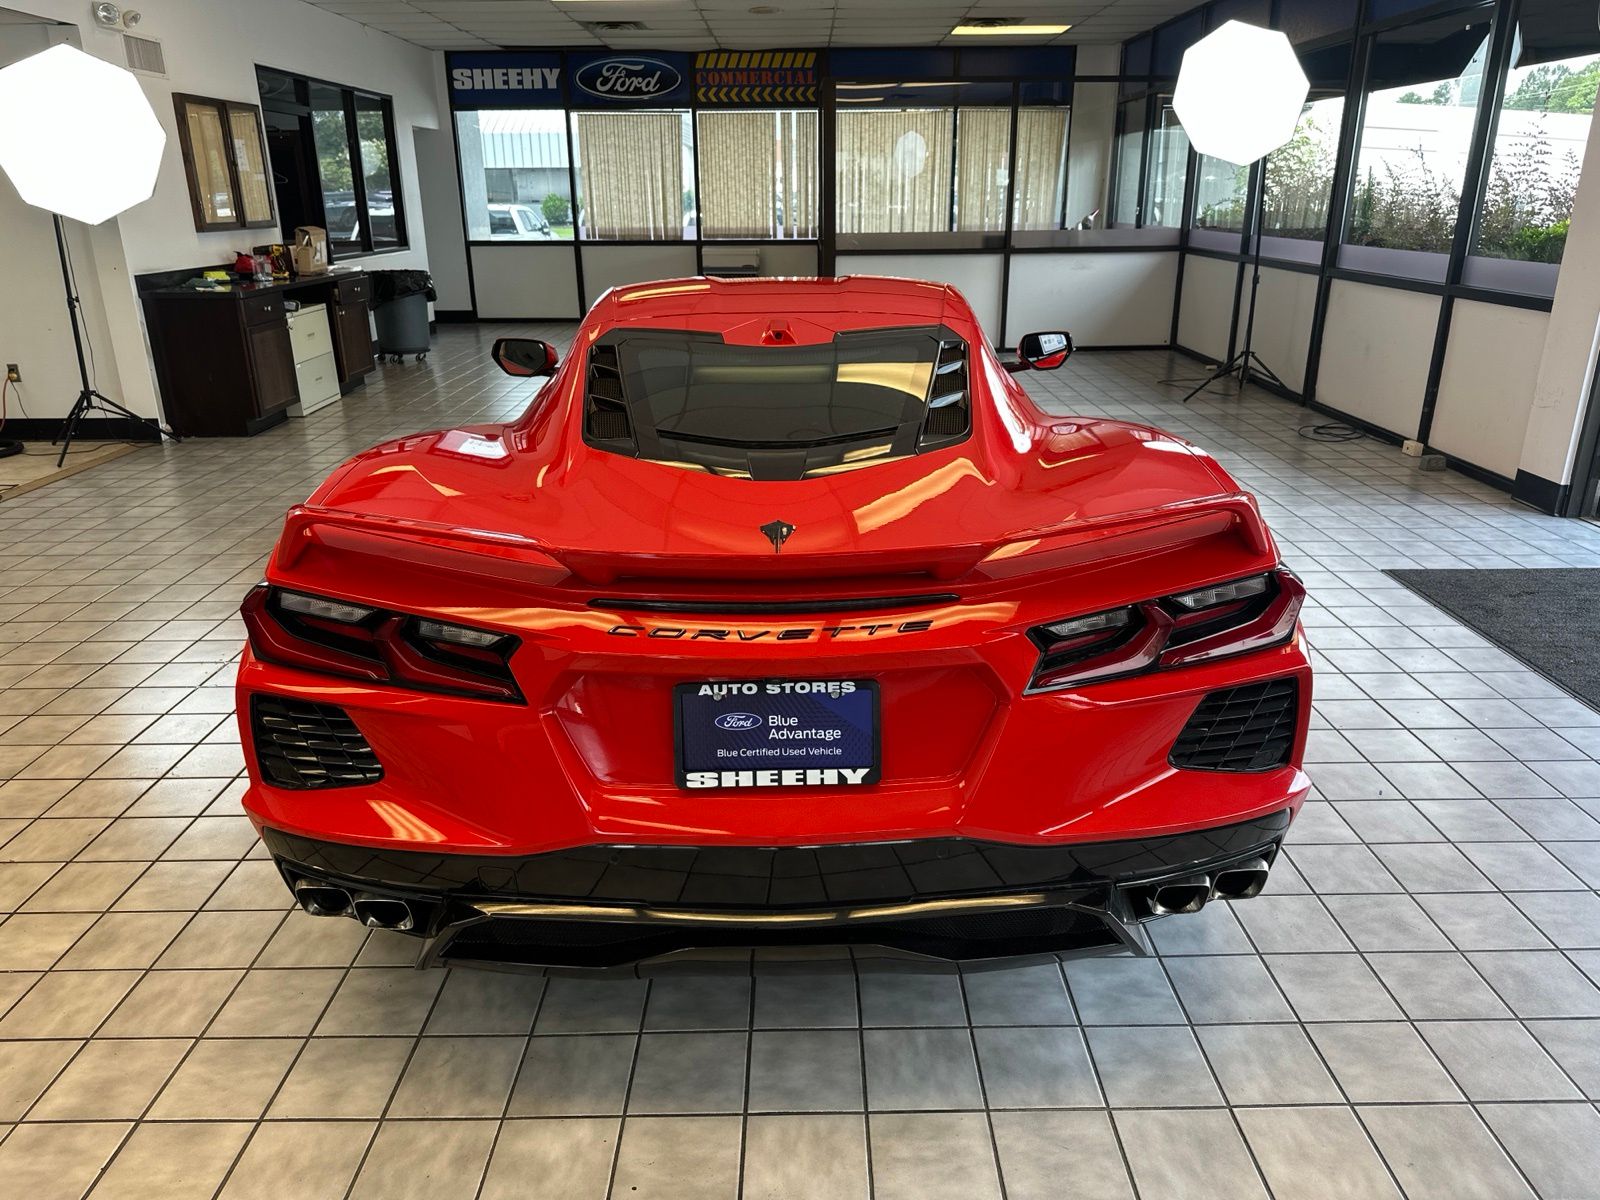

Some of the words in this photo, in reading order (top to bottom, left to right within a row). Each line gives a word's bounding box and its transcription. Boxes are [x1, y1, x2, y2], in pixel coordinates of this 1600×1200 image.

[452, 68, 560, 90] SHEEHY
[595, 63, 661, 94] Ford
[696, 70, 816, 86] COMMERCIAL
[607, 620, 933, 641] CORVETTE
[698, 683, 758, 696] AUTO
[766, 681, 856, 695] STORES
[724, 715, 753, 728] Ford
[768, 715, 798, 727] Blue
[768, 729, 841, 741] Advantage
[717, 749, 738, 757] Blue
[740, 747, 780, 757] Certified
[782, 747, 806, 756] Used
[808, 746, 842, 756] Vehicle
[686, 768, 870, 788] SHEEHY
